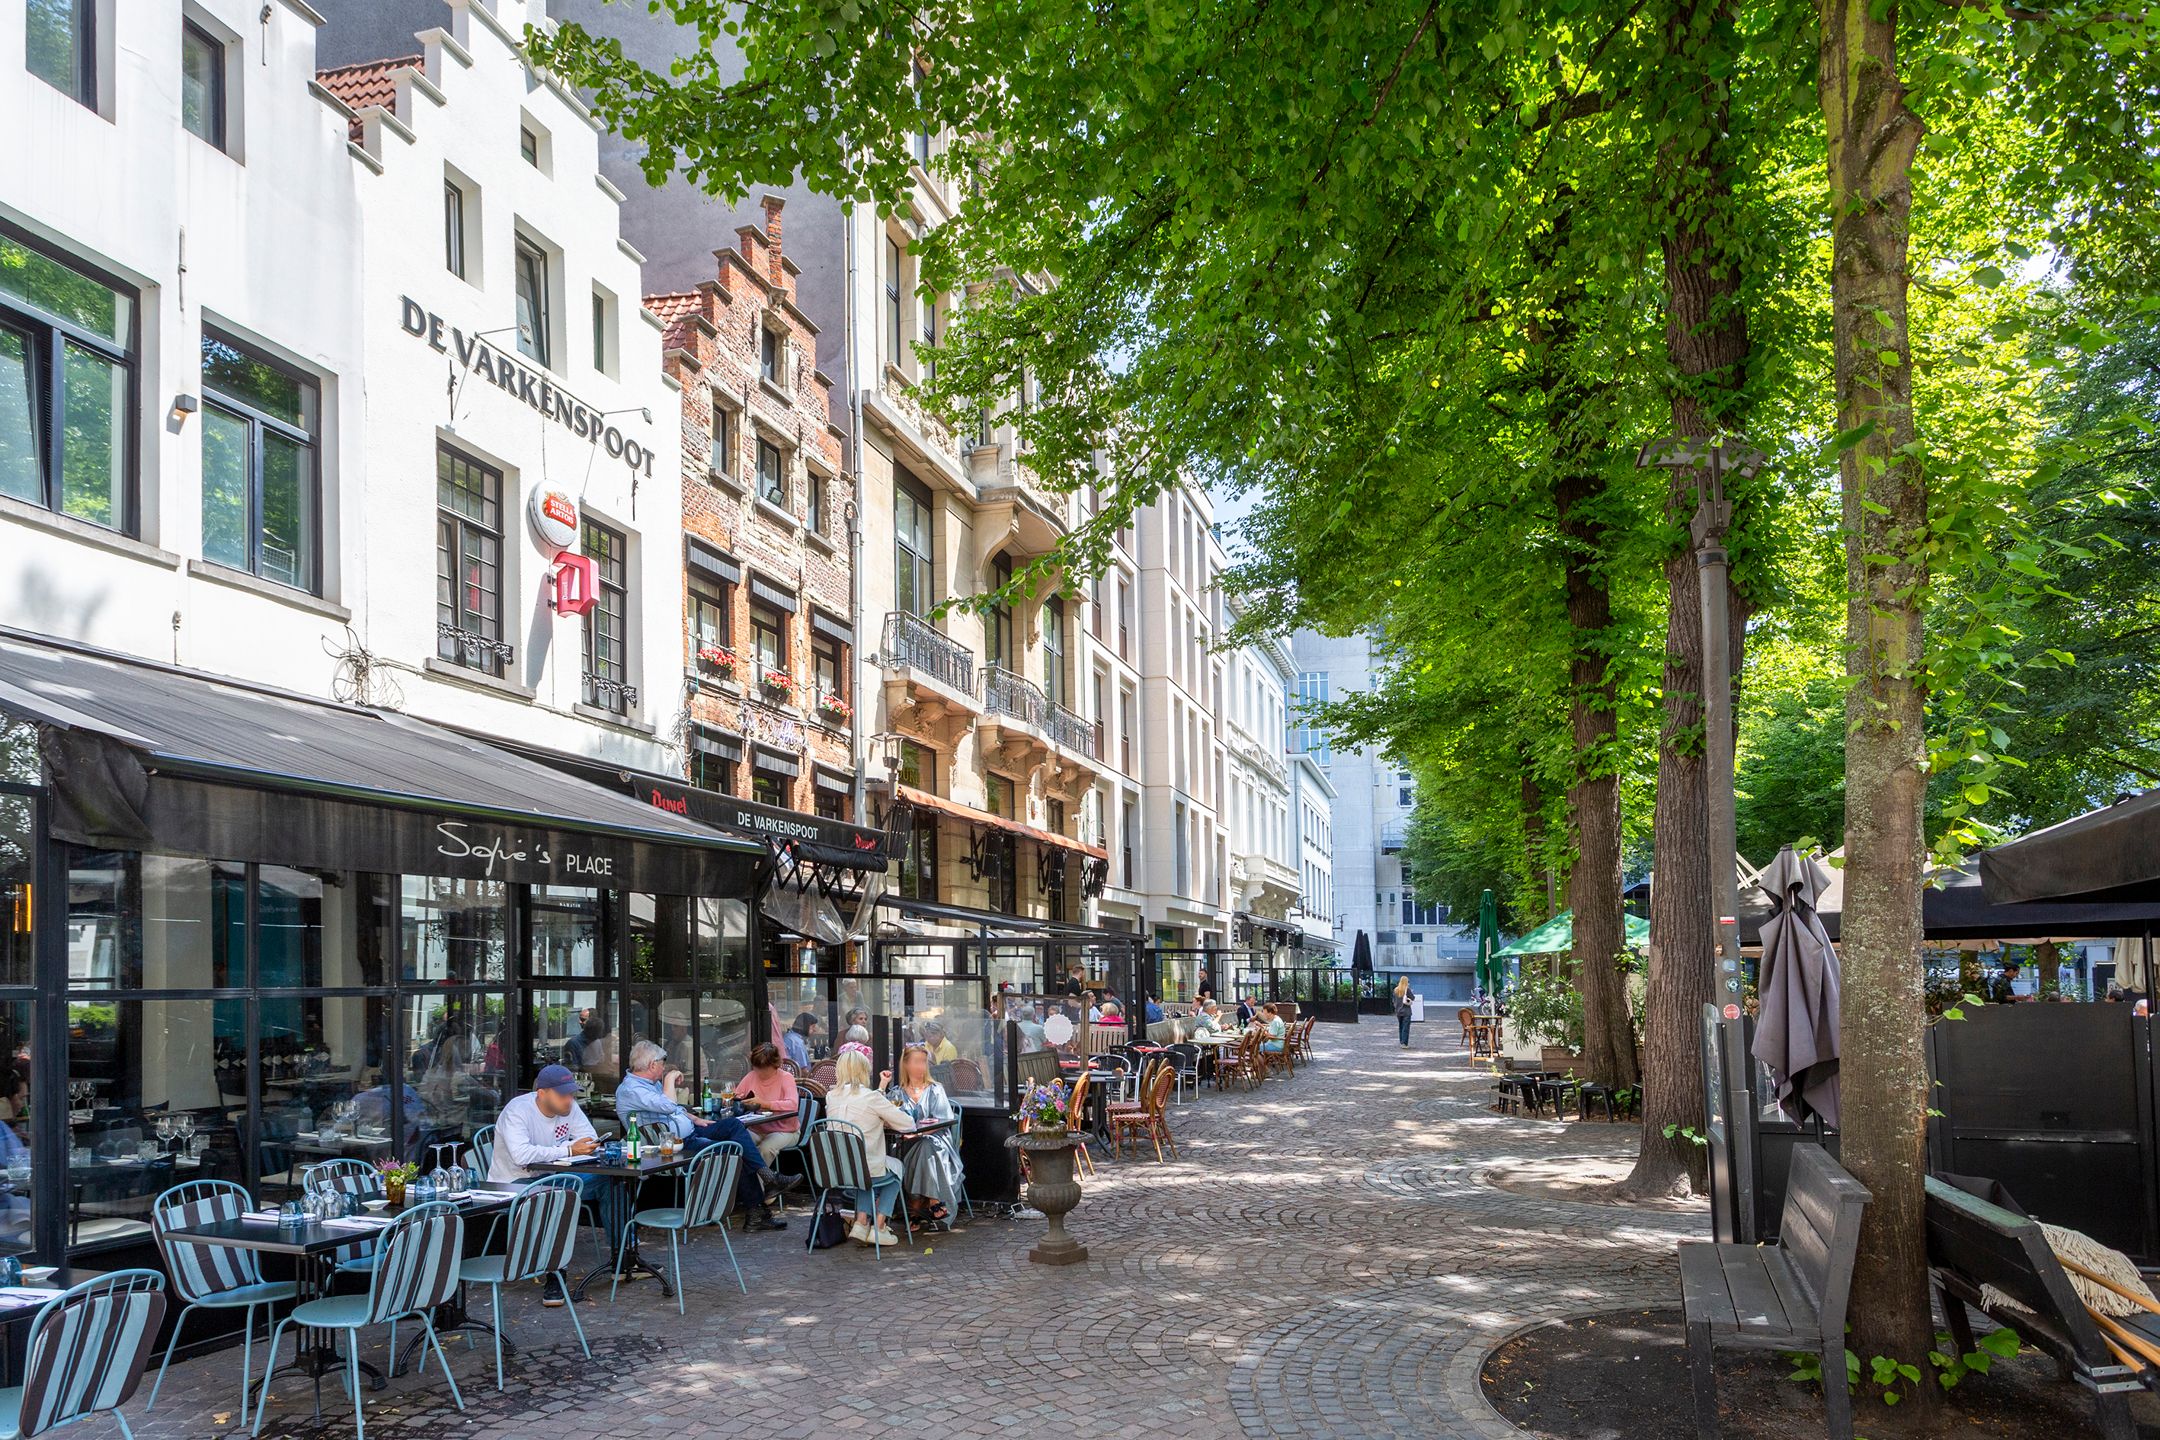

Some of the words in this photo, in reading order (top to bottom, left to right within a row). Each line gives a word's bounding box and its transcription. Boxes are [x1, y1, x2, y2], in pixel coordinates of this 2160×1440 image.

[401, 294, 447, 354] DE
[452, 327, 655, 478] VARKENSPOOT
[550, 500, 574, 517] STELLA
[550, 507, 574, 524] ARTOIS
[652, 788, 688, 815] Duvel
[737, 811, 751, 827] DE
[753, 815, 819, 840] VARKENSPOOT
[566, 854, 613, 876] PLACE
